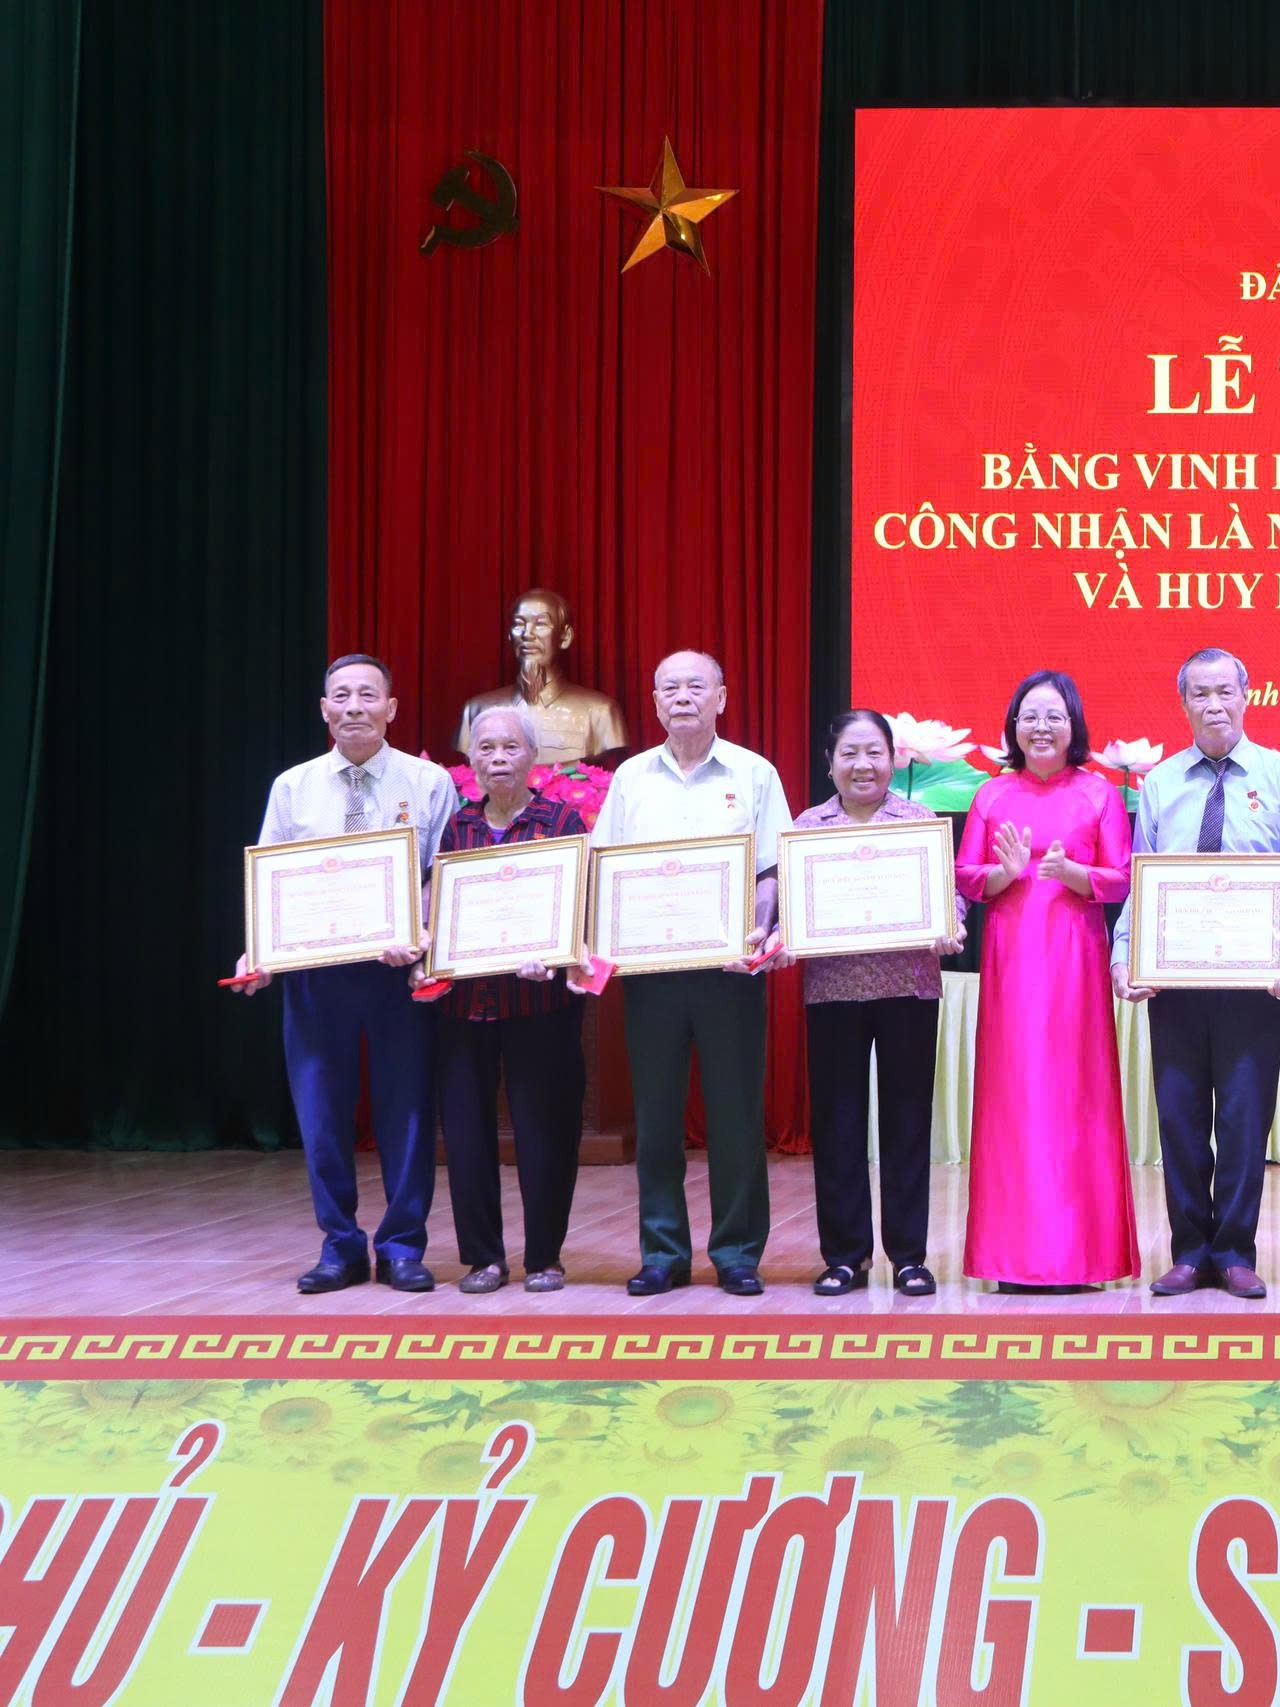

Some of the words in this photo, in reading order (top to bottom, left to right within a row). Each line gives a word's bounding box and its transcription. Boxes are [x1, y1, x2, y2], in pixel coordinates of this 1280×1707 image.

[1147, 335, 1255, 414] LỄ
[981, 442, 1120, 490] BẰNG
[1133, 453, 1258, 490] VINH
[873, 502, 1018, 549] CÔNG
[1031, 508, 1173, 560] NHẬN
[1186, 503, 1253, 549] LÀ
[1073, 562, 1143, 609] VÀ
[1157, 572, 1264, 609] HUY
[1247, 681, 1279, 706] nh
[0, 1419, 226, 1707] HỦ
[276, 1419, 538, 1707] KỶ
[524, 1472, 1042, 1707] CƯƠNG
